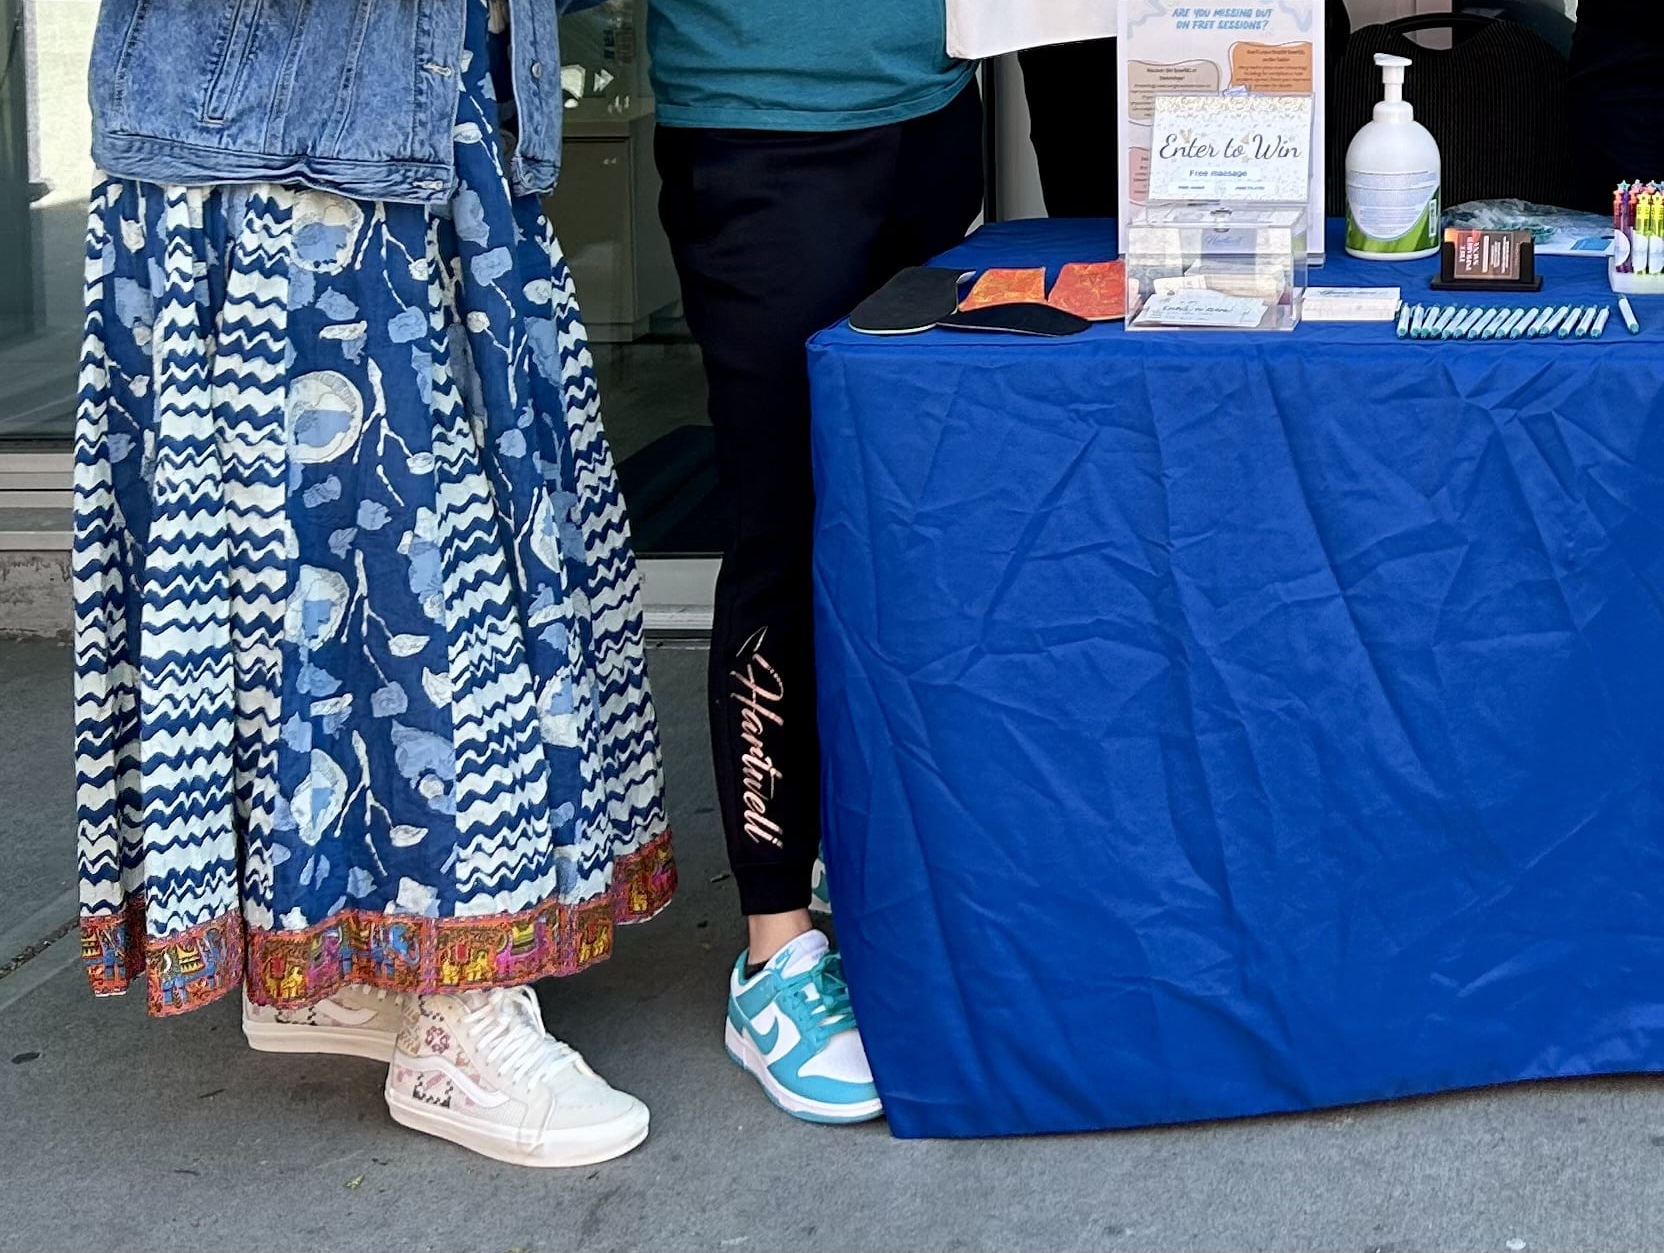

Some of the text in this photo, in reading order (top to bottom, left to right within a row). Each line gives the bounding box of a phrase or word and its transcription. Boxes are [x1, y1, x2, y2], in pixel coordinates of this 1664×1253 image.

[1172, 8, 1273, 17] ARE YOU MISSING OUT
[1176, 19, 1268, 31] ON FREE SESSIONS?
[1159, 133, 1302, 160] Enter to Win
[1189, 168, 1248, 178] Free massage
[729, 652, 784, 849] Hartwell
